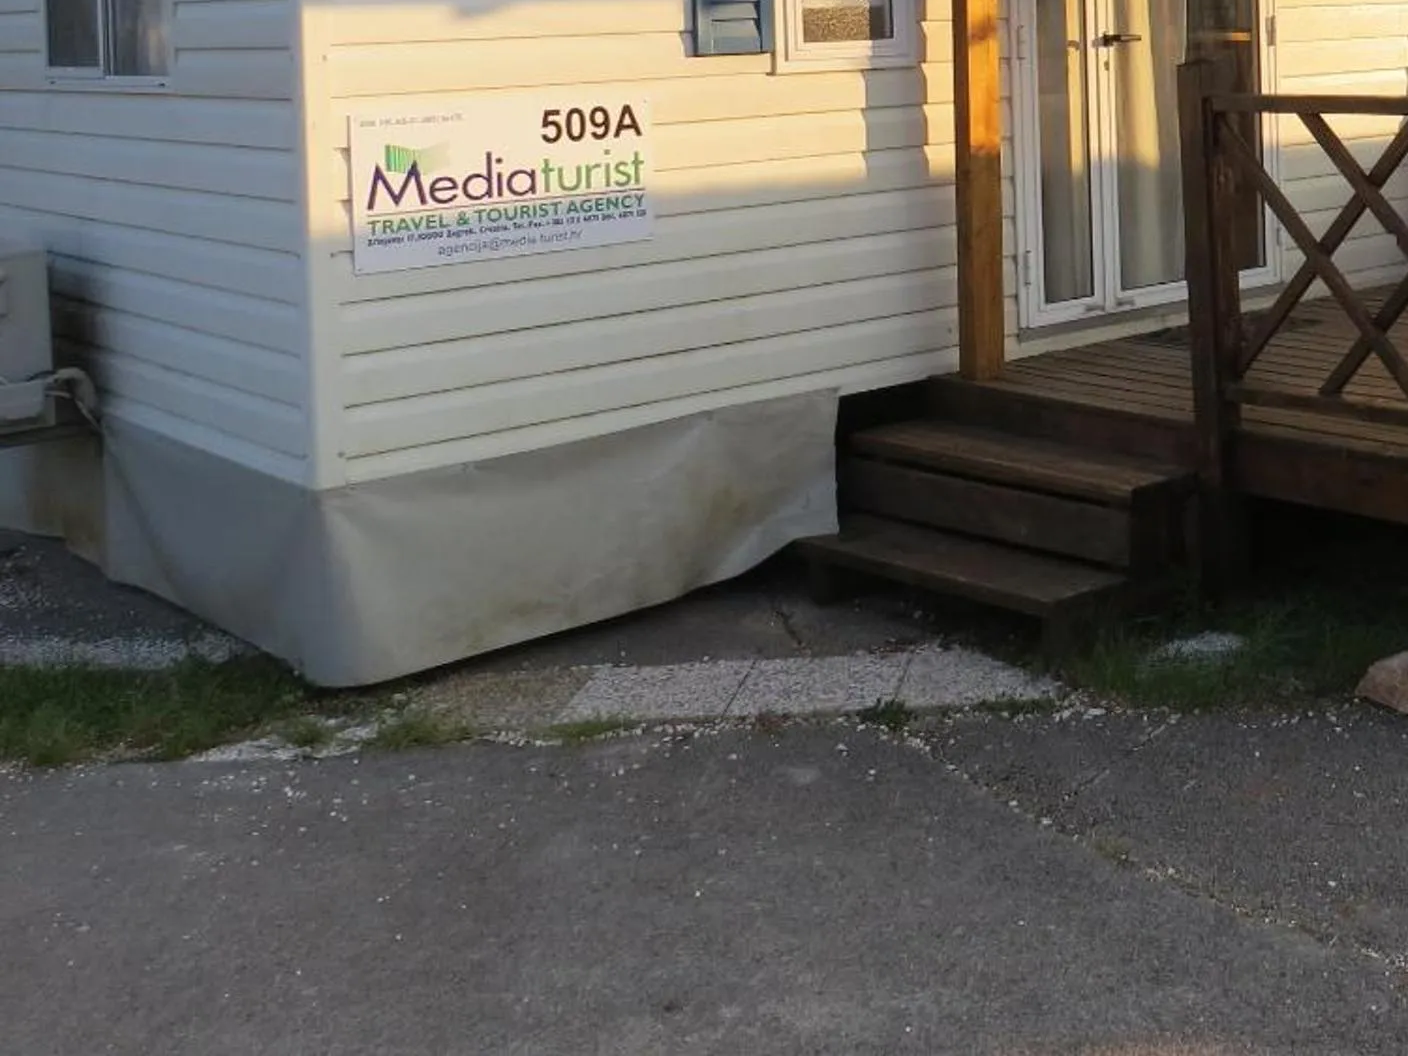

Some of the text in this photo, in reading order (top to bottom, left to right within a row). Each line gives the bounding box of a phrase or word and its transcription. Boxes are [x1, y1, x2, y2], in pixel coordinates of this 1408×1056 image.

[541, 103, 643, 144] 509A
[367, 213, 450, 237] TRAVEL
[457, 211, 471, 225] &
[473, 202, 565, 225] TOURIST
[566, 194, 645, 214] AGENCY
